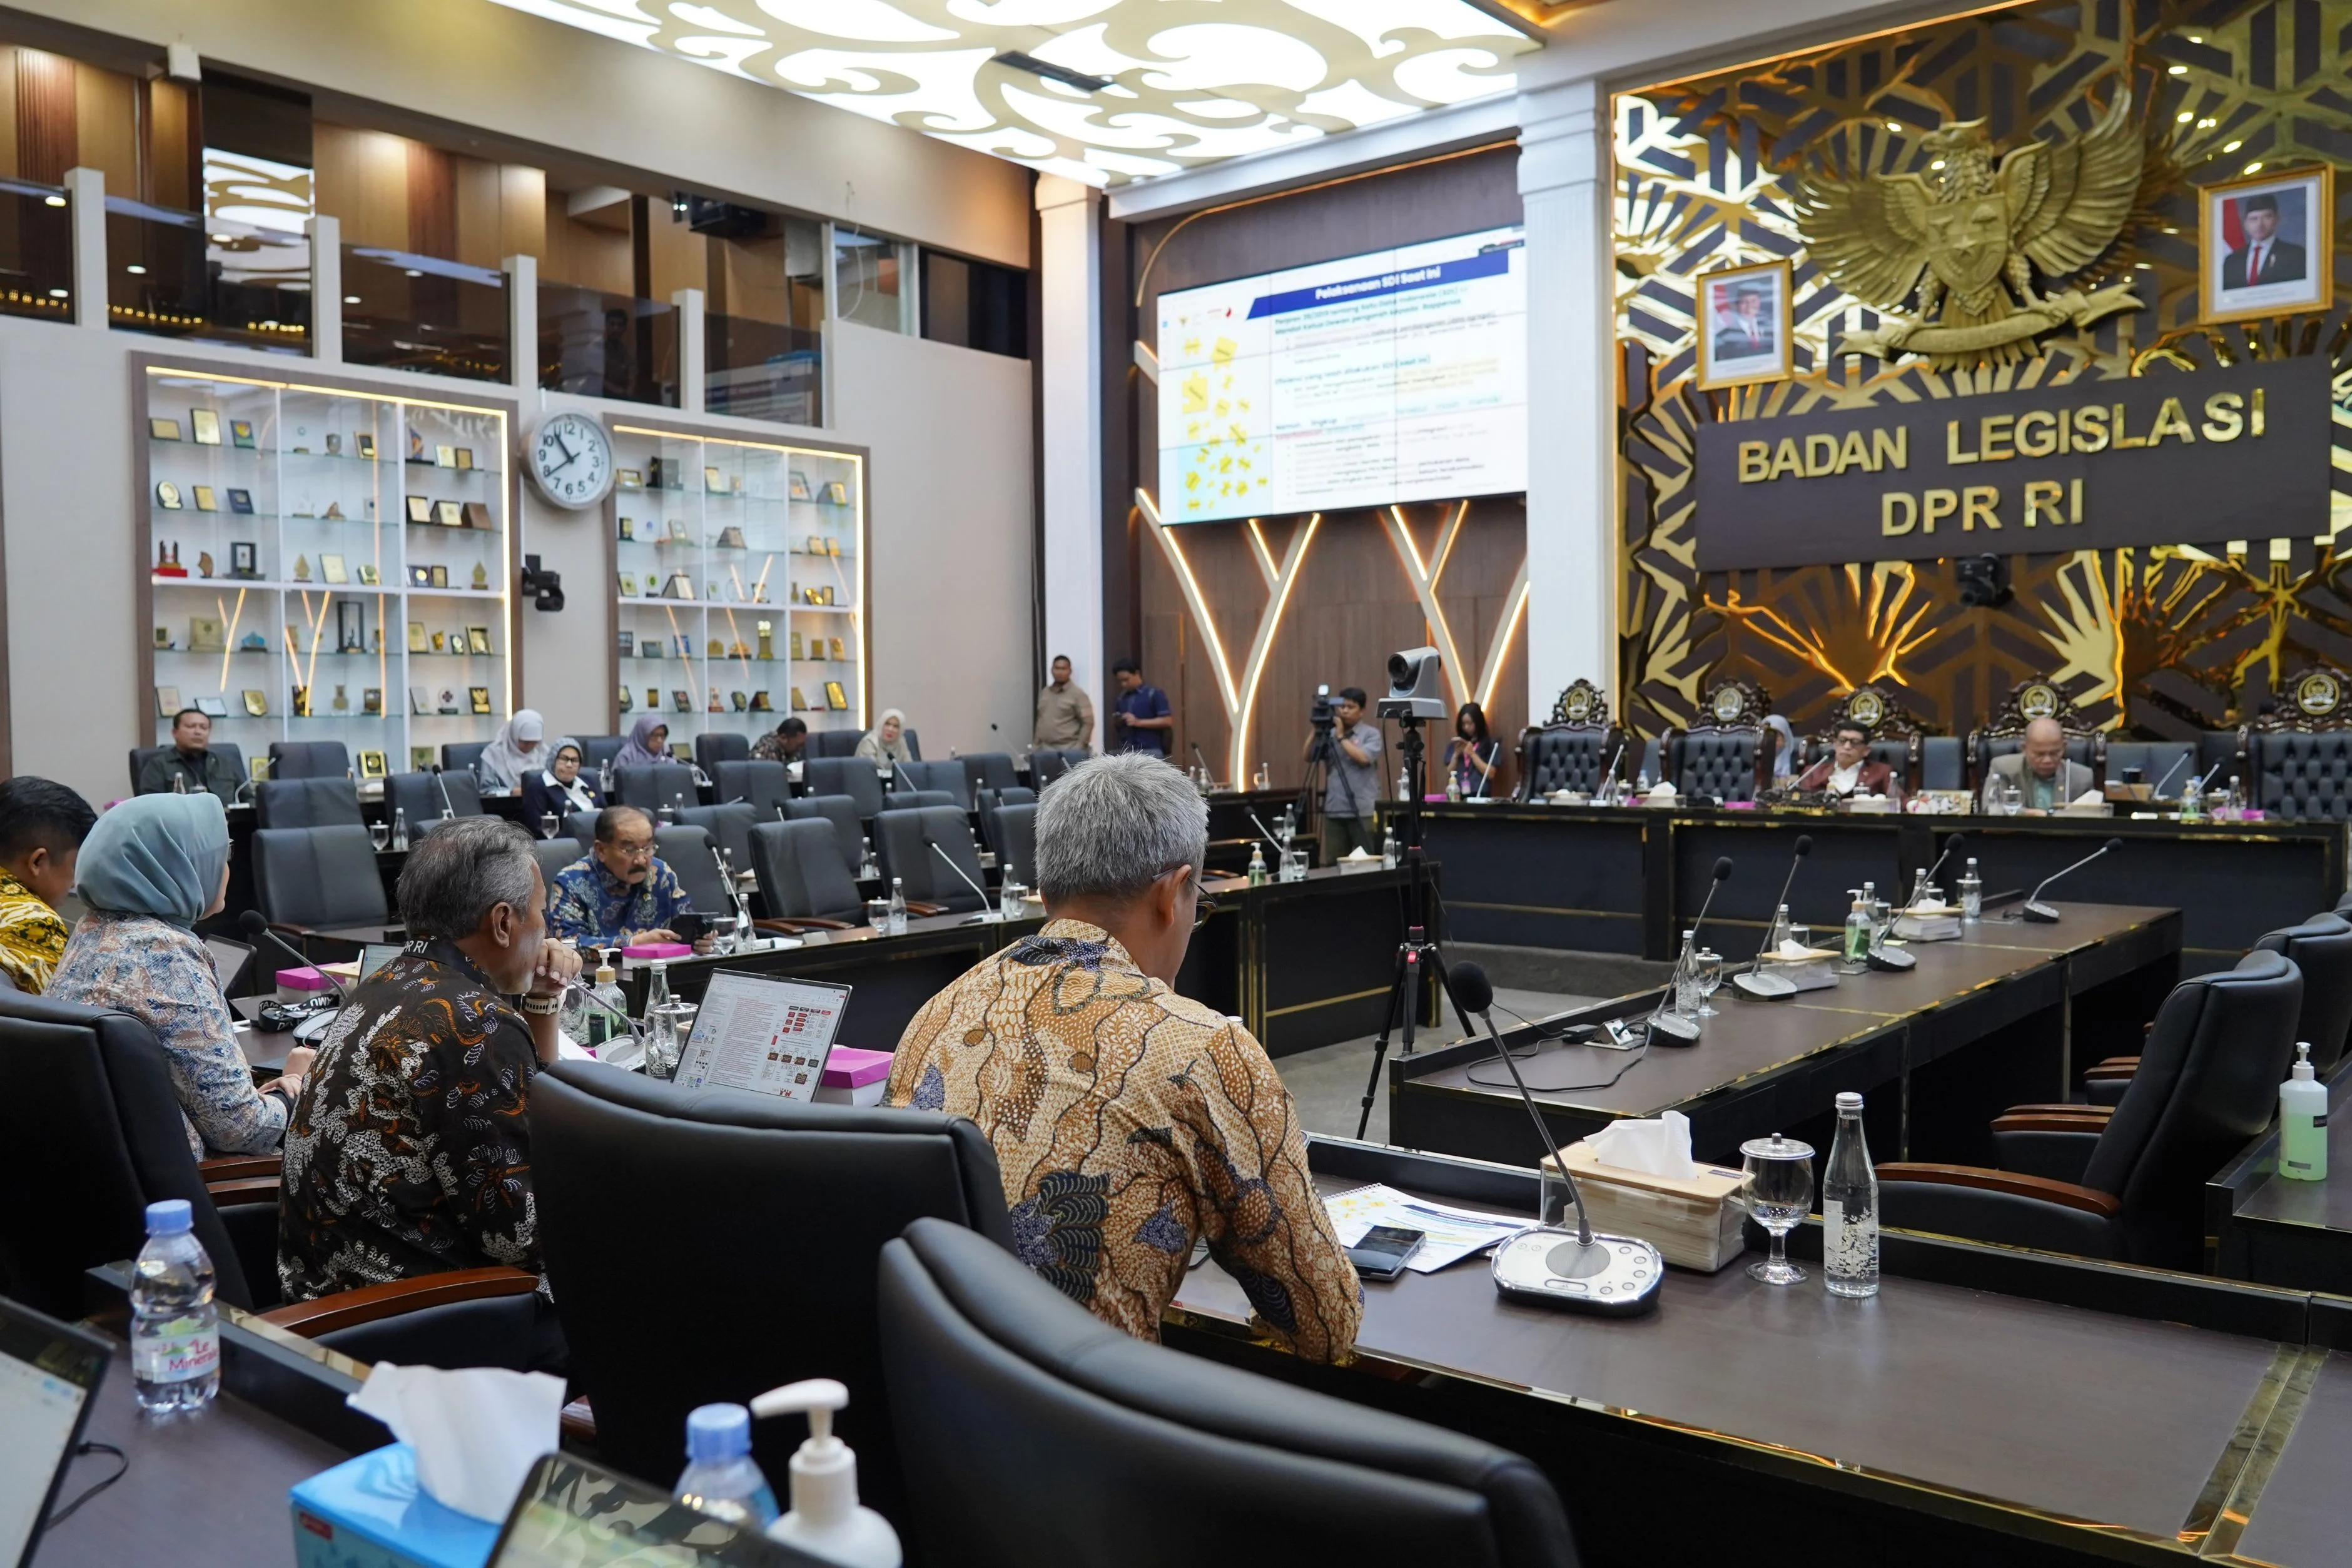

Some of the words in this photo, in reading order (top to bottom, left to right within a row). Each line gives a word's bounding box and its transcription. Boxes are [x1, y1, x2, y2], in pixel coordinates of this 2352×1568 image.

[564, 422, 575, 435] 12
[580, 428, 584, 440] 1
[543, 435, 554, 447] 10
[1738, 425, 1907, 483] BADAN
[1947, 387, 2265, 465] LEGISLASI
[588, 440, 596, 452] 2
[539, 449, 547, 462] 9
[592, 456, 599, 468] 3
[543, 465, 551, 478] 8
[587, 472, 595, 482] 4
[554, 477, 561, 490] 7
[565, 483, 574, 495] 6
[577, 480, 585, 492] 5
[1882, 485, 2002, 537] DPR
[2024, 478, 2083, 527] RI
[413, 940, 428, 954] RI
